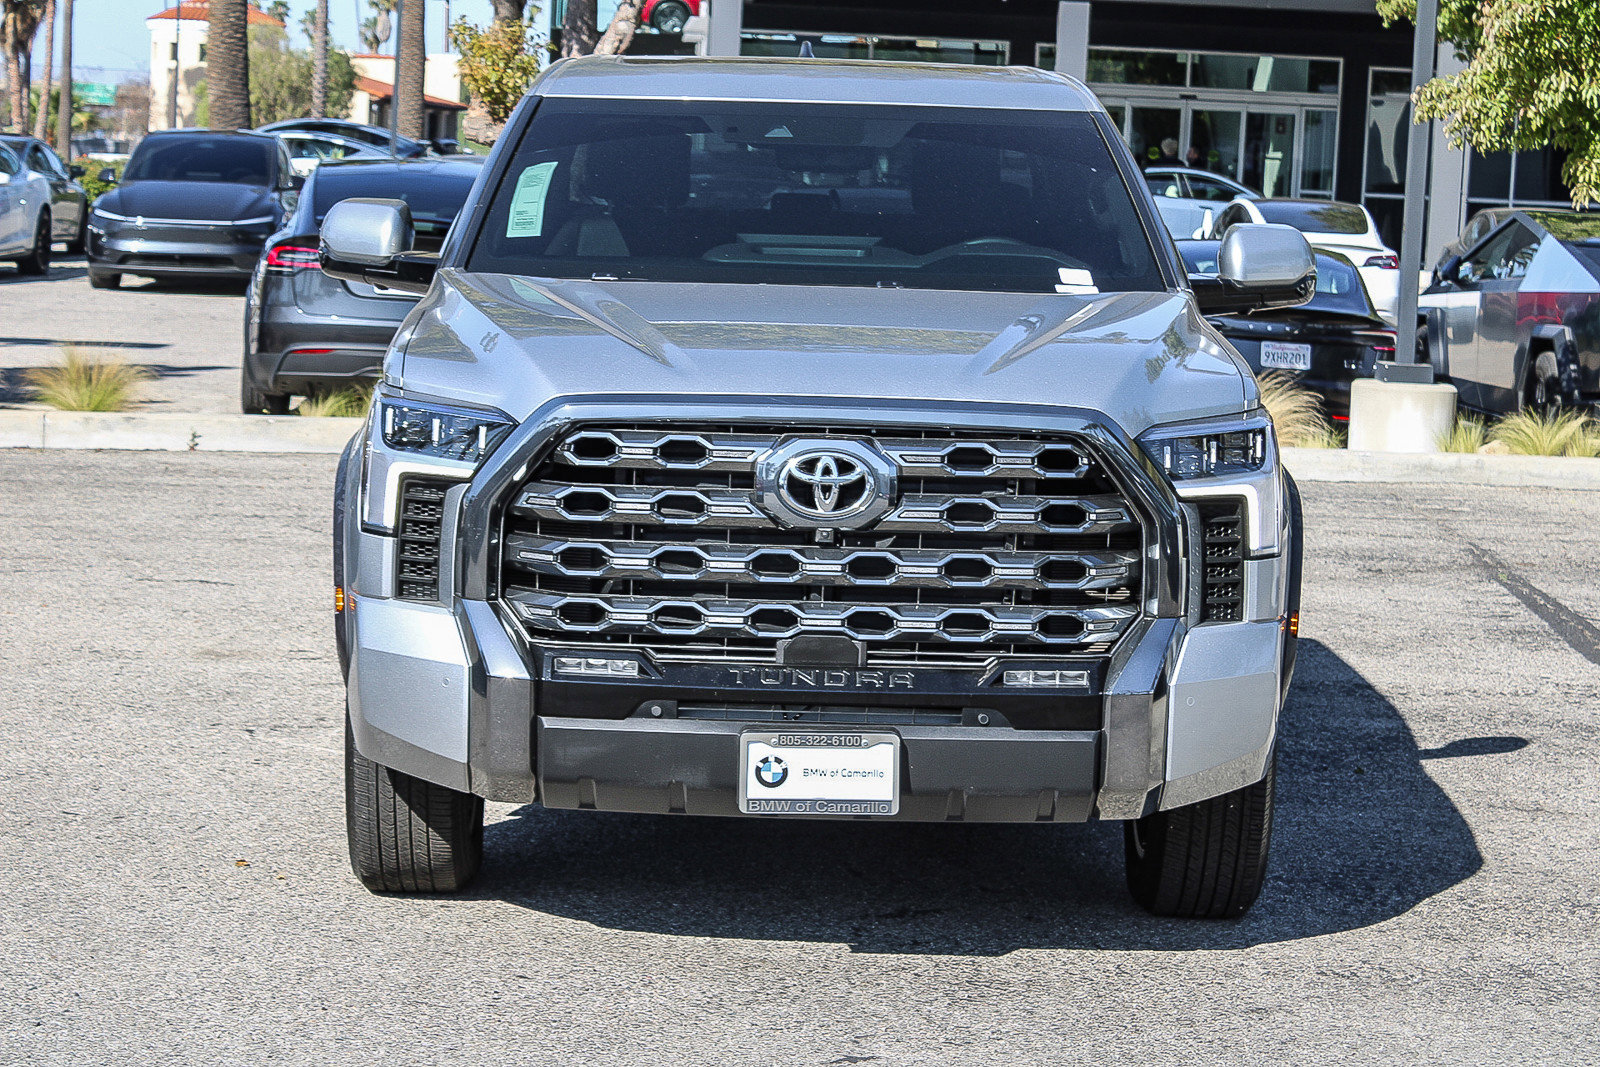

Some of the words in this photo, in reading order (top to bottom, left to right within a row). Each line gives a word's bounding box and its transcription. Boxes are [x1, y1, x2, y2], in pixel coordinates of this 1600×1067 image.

[1264, 351, 1307, 365] 9XHR201
[729, 667, 915, 689] TUNDRA
[779, 735, 861, 746] 805-322-6100
[803, 768, 828, 778] BMW
[830, 768, 839, 778] of
[841, 768, 884, 778] Camarillo
[748, 800, 791, 812] BMW
[795, 800, 812, 812] of
[815, 801, 889, 813] Camarillo
